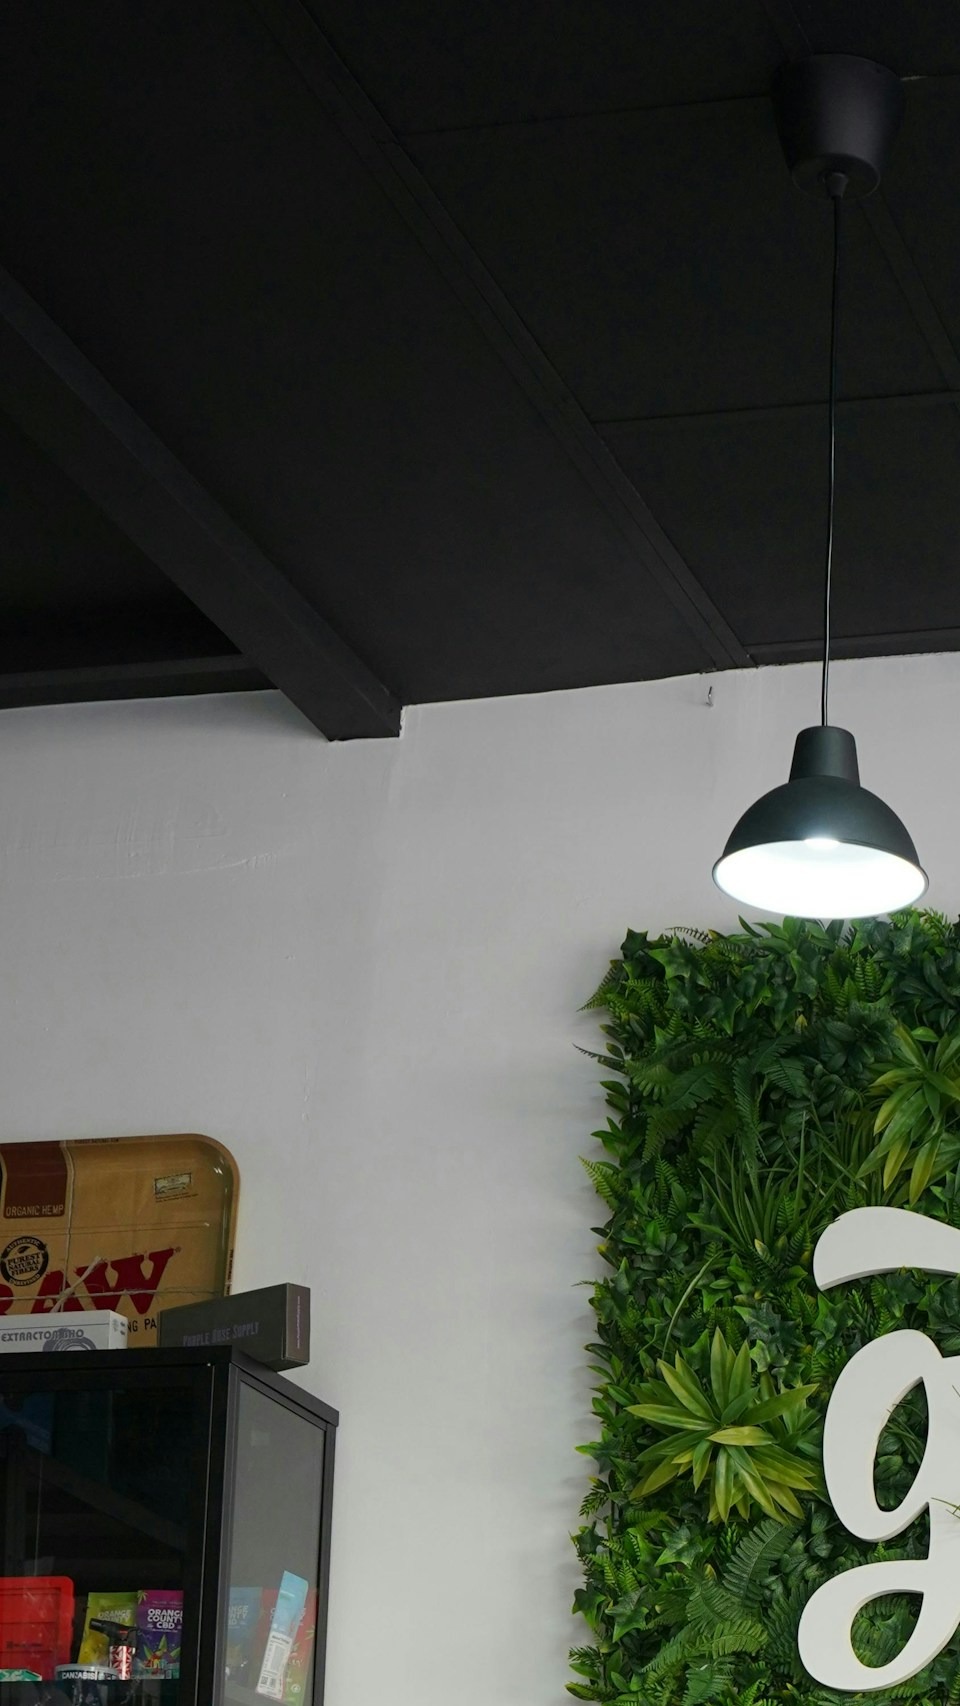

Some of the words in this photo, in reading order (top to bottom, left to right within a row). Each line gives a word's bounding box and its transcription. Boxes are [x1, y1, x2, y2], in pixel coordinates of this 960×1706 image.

[6, 1206, 40, 1217] ORGANIC
[42, 1204, 64, 1216] HEMP
[8, 1252, 41, 1265] PUREST
[0, 1248, 175, 1315] AW
[156, 1621, 175, 1629] CBD
